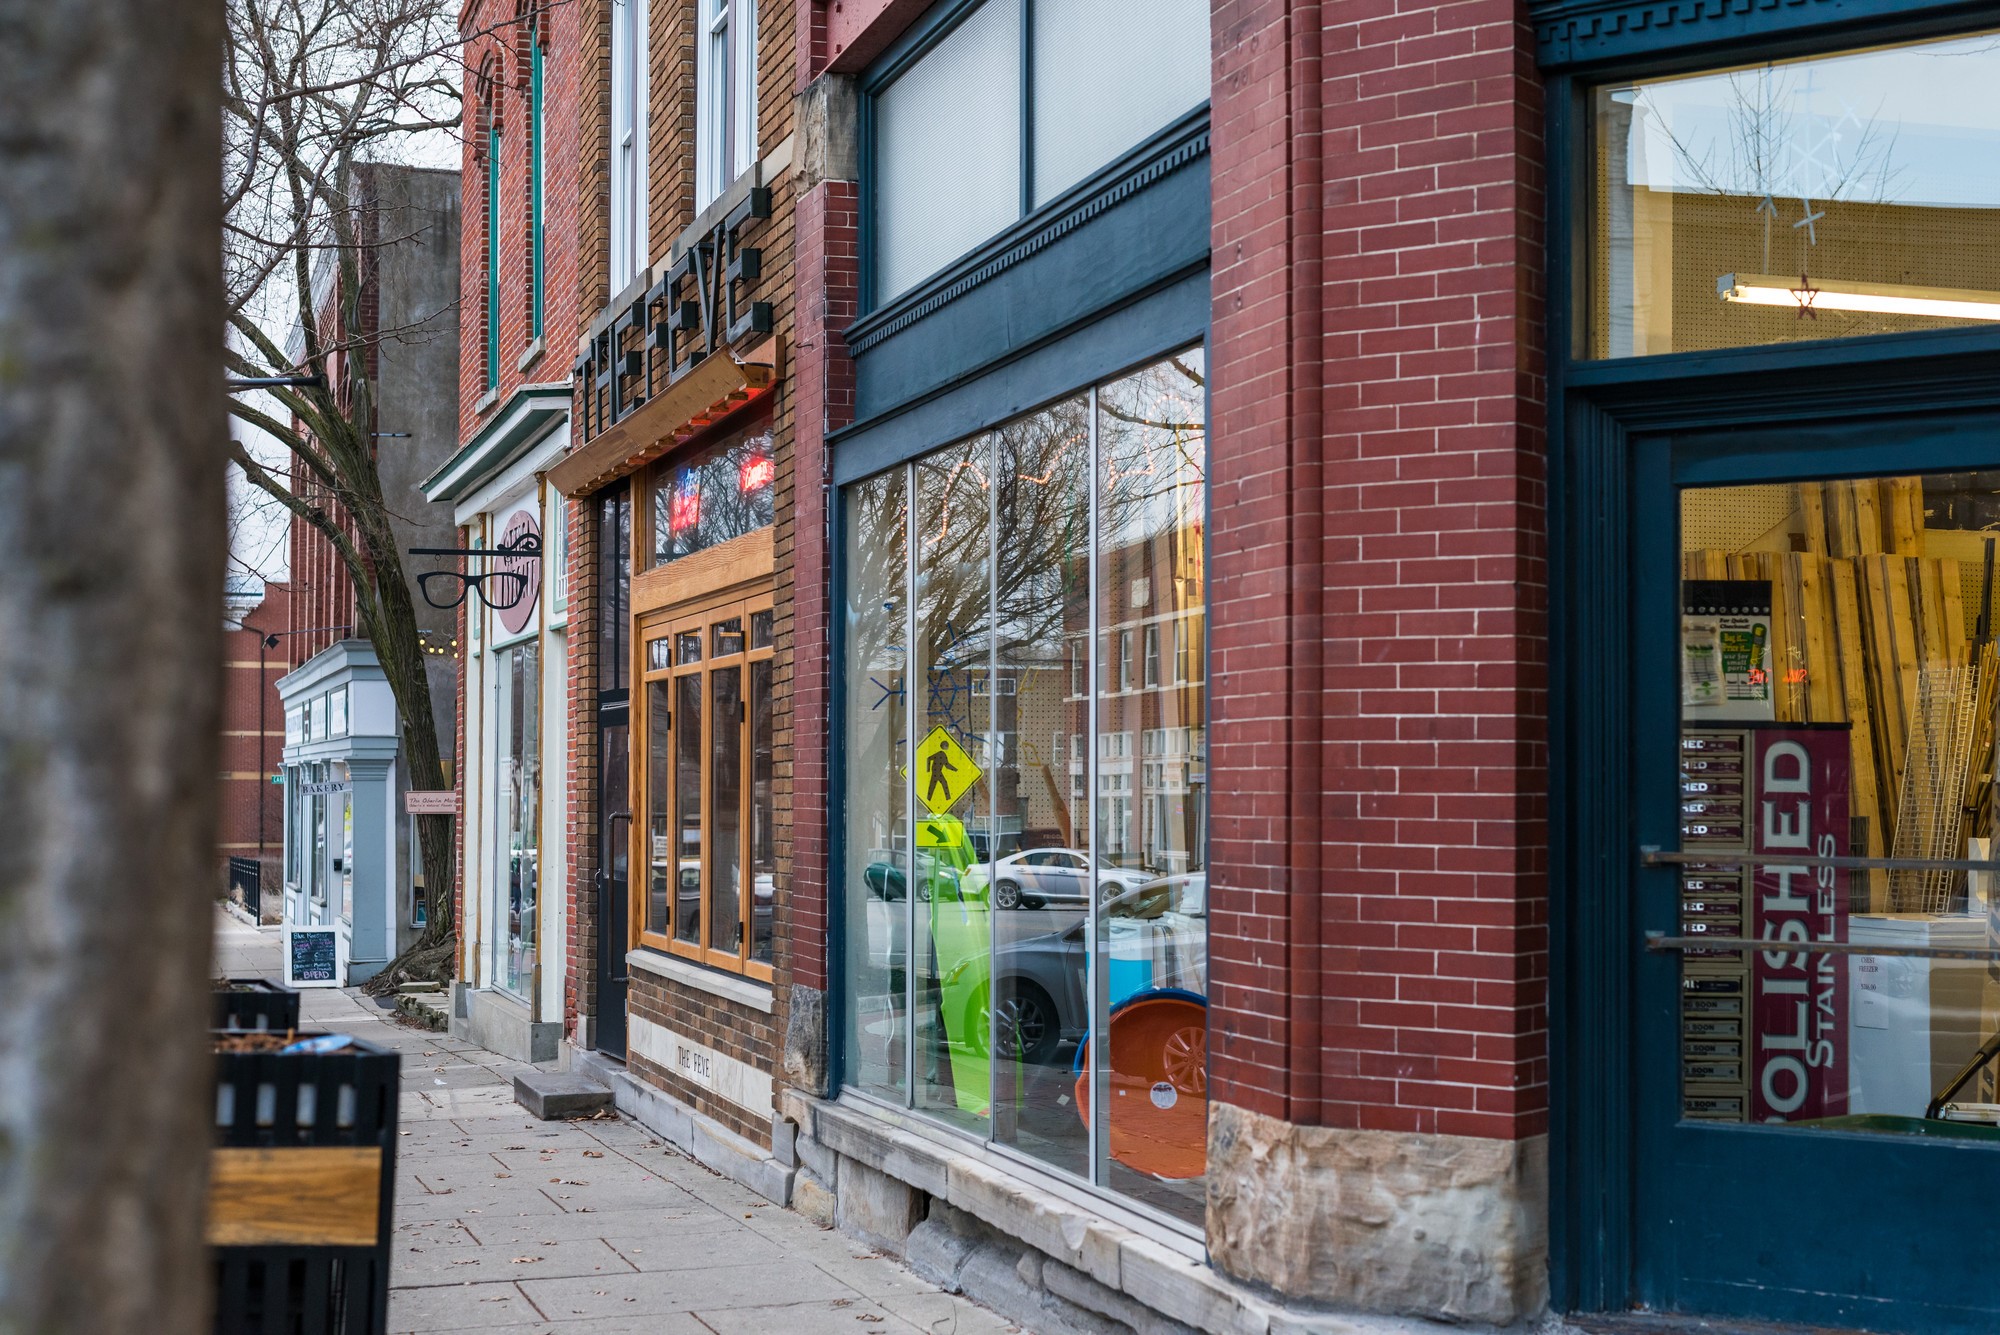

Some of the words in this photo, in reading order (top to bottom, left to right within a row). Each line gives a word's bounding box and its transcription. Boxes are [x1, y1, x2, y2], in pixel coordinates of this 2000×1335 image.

[576, 302, 645, 444] THE
[645, 187, 773, 401] FEVE
[302, 783, 345, 794] BAKERY
[1761, 739, 1811, 1122] OLISHED
[1806, 833, 1836, 1068] STAINLESS
[1860, 956, 1875, 964] CHEST
[1858, 965, 1879, 973] FREEZER
[303, 970, 330, 980] BREAD
[1695, 1000, 1718, 1009] SOON
[1692, 1023, 1715, 1031] SOON
[678, 1045, 690, 1069] THE
[693, 1053, 710, 1078] FEVE
[1692, 1067, 1714, 1075] SOON
[1694, 1100, 1717, 1108] SOON
